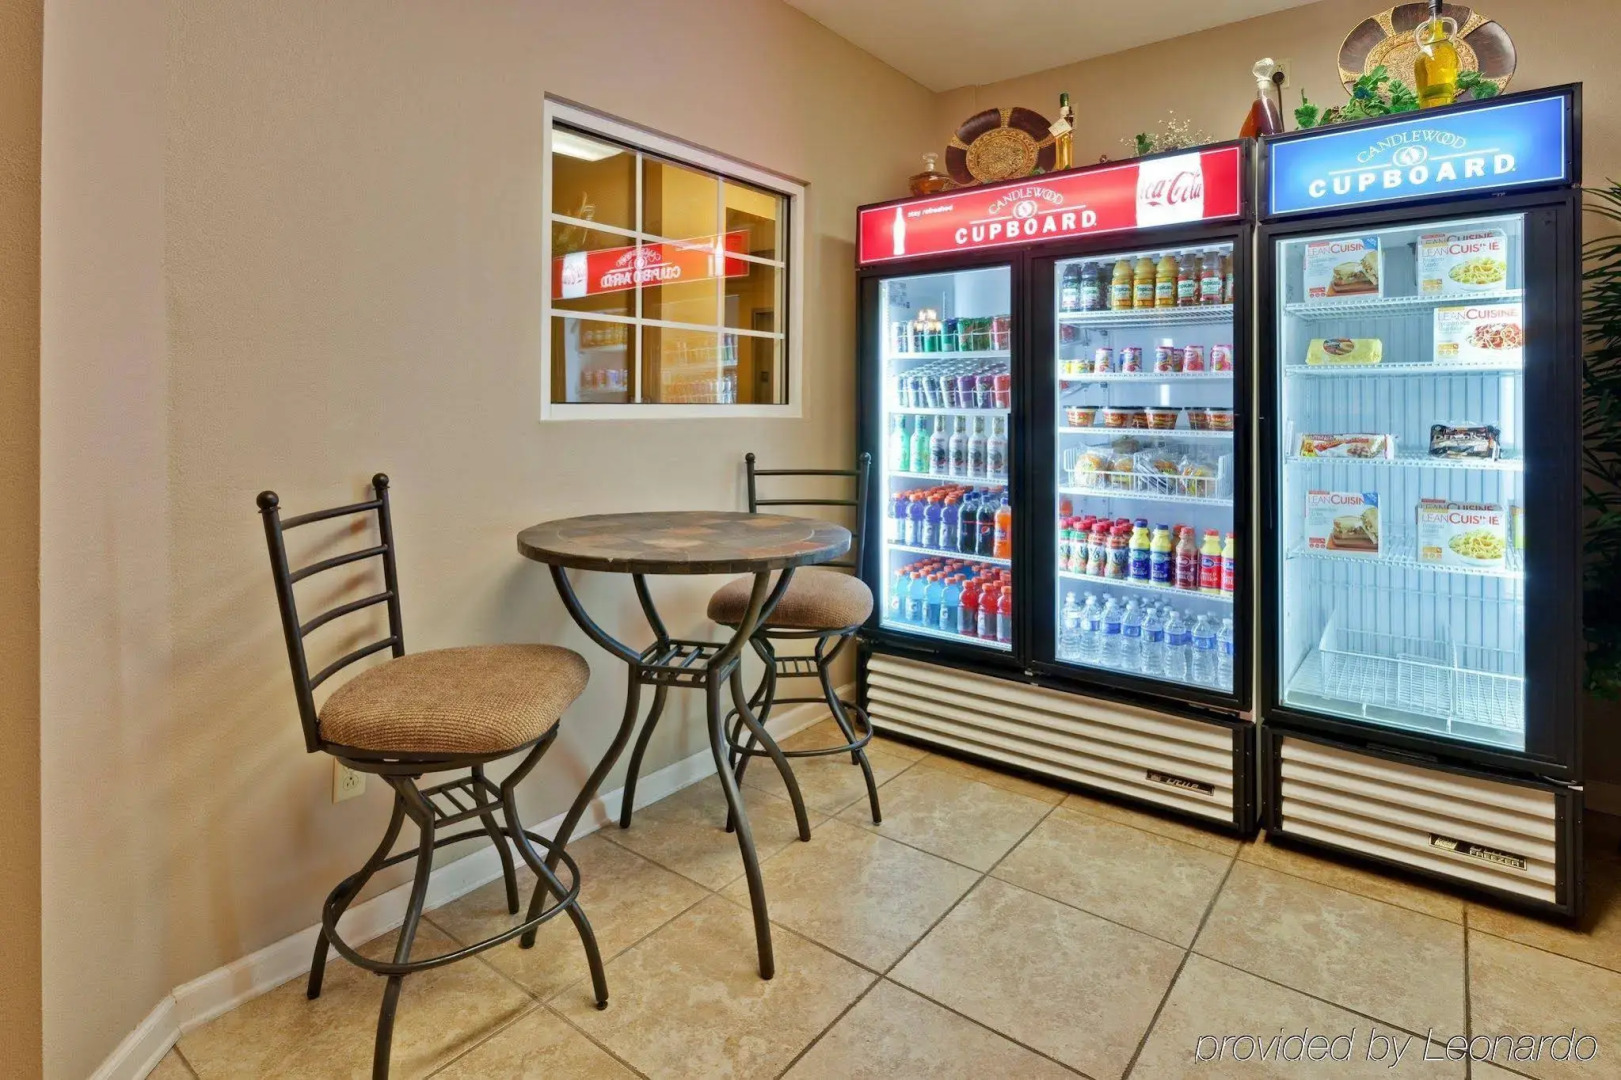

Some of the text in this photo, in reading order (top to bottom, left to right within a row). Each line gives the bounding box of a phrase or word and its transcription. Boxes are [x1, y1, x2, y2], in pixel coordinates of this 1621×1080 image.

[1357, 128, 1467, 163] CANDLEWOOD
[1140, 171, 1202, 207] ca-Cola
[1308, 153, 1516, 198] CUPBOARD
[988, 186, 1064, 215] CANDLEWOOD
[955, 210, 1097, 245] CUPBOARD
[1330, 243, 1364, 254] CUISIN
[1449, 241, 1500, 255] CUISE
[1330, 494, 1365, 506] CUISIN
[1449, 512, 1500, 526] CUISE
